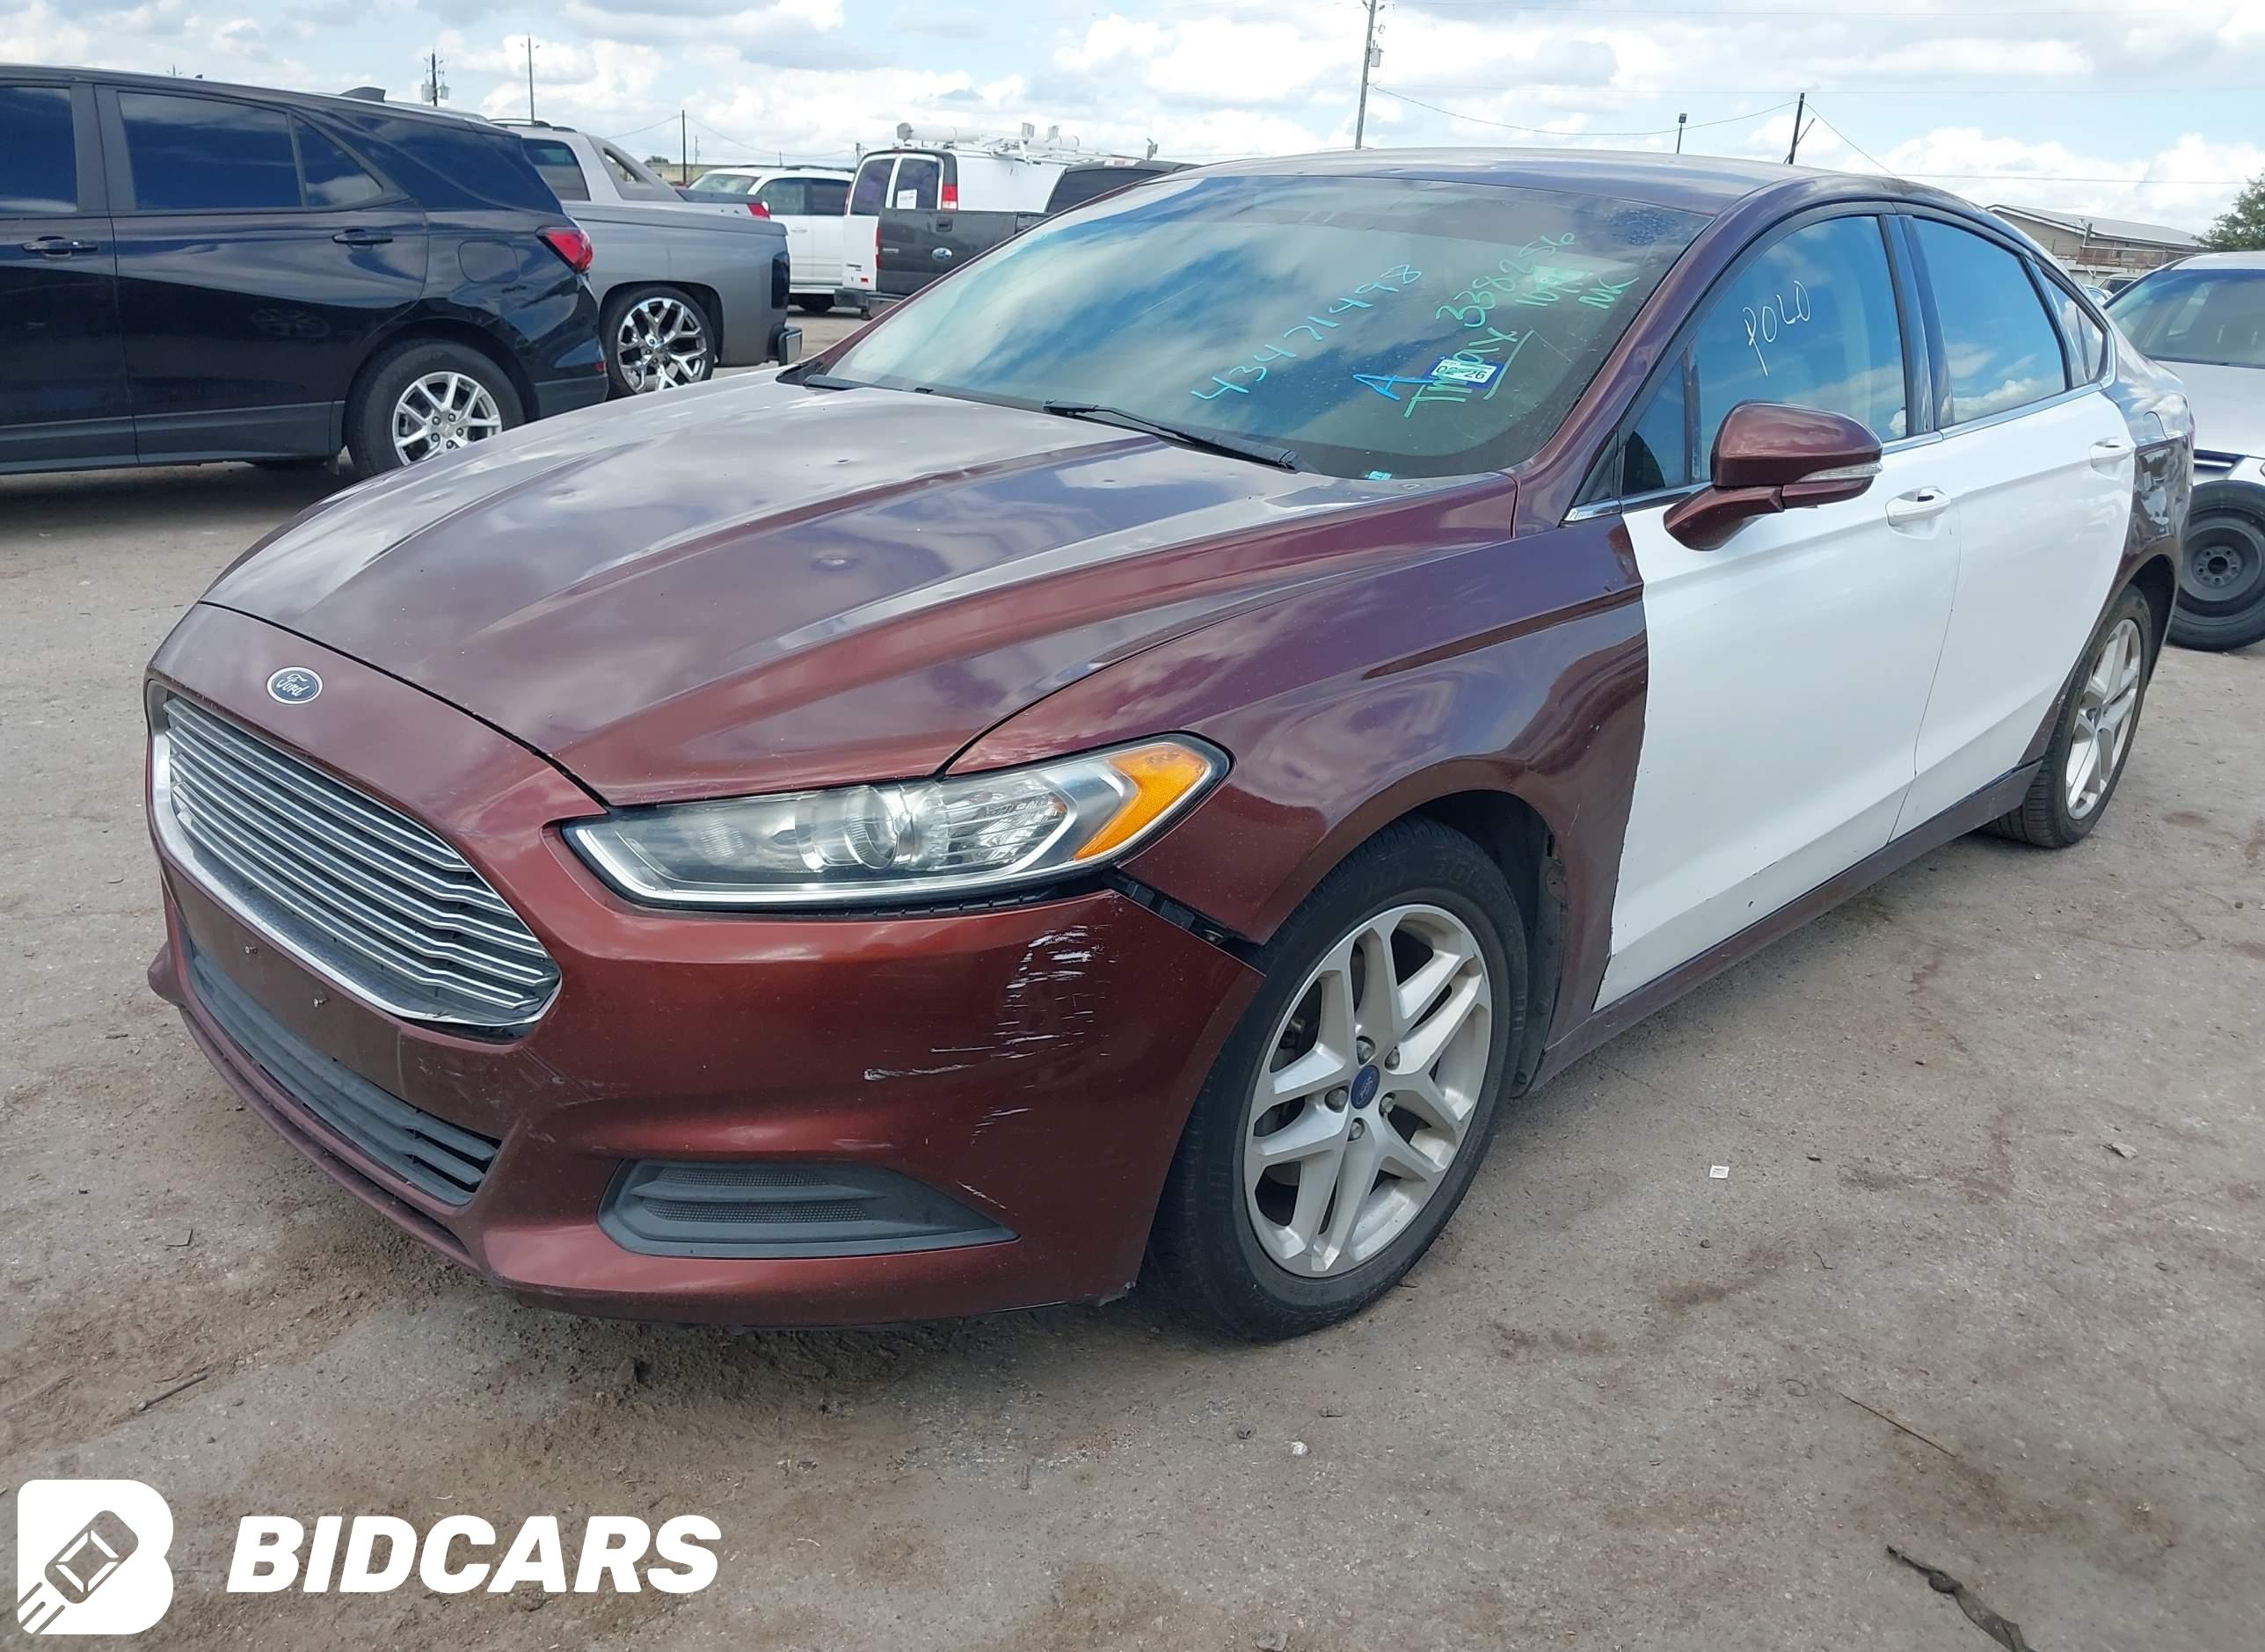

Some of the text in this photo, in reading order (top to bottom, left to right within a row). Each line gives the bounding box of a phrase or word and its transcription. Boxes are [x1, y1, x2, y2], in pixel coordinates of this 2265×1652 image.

[1190, 263, 1422, 401] 43471498
[1742, 280, 1810, 377] POLO
[1463, 369, 1488, 380] 26
[275, 673, 310, 697] Ford
